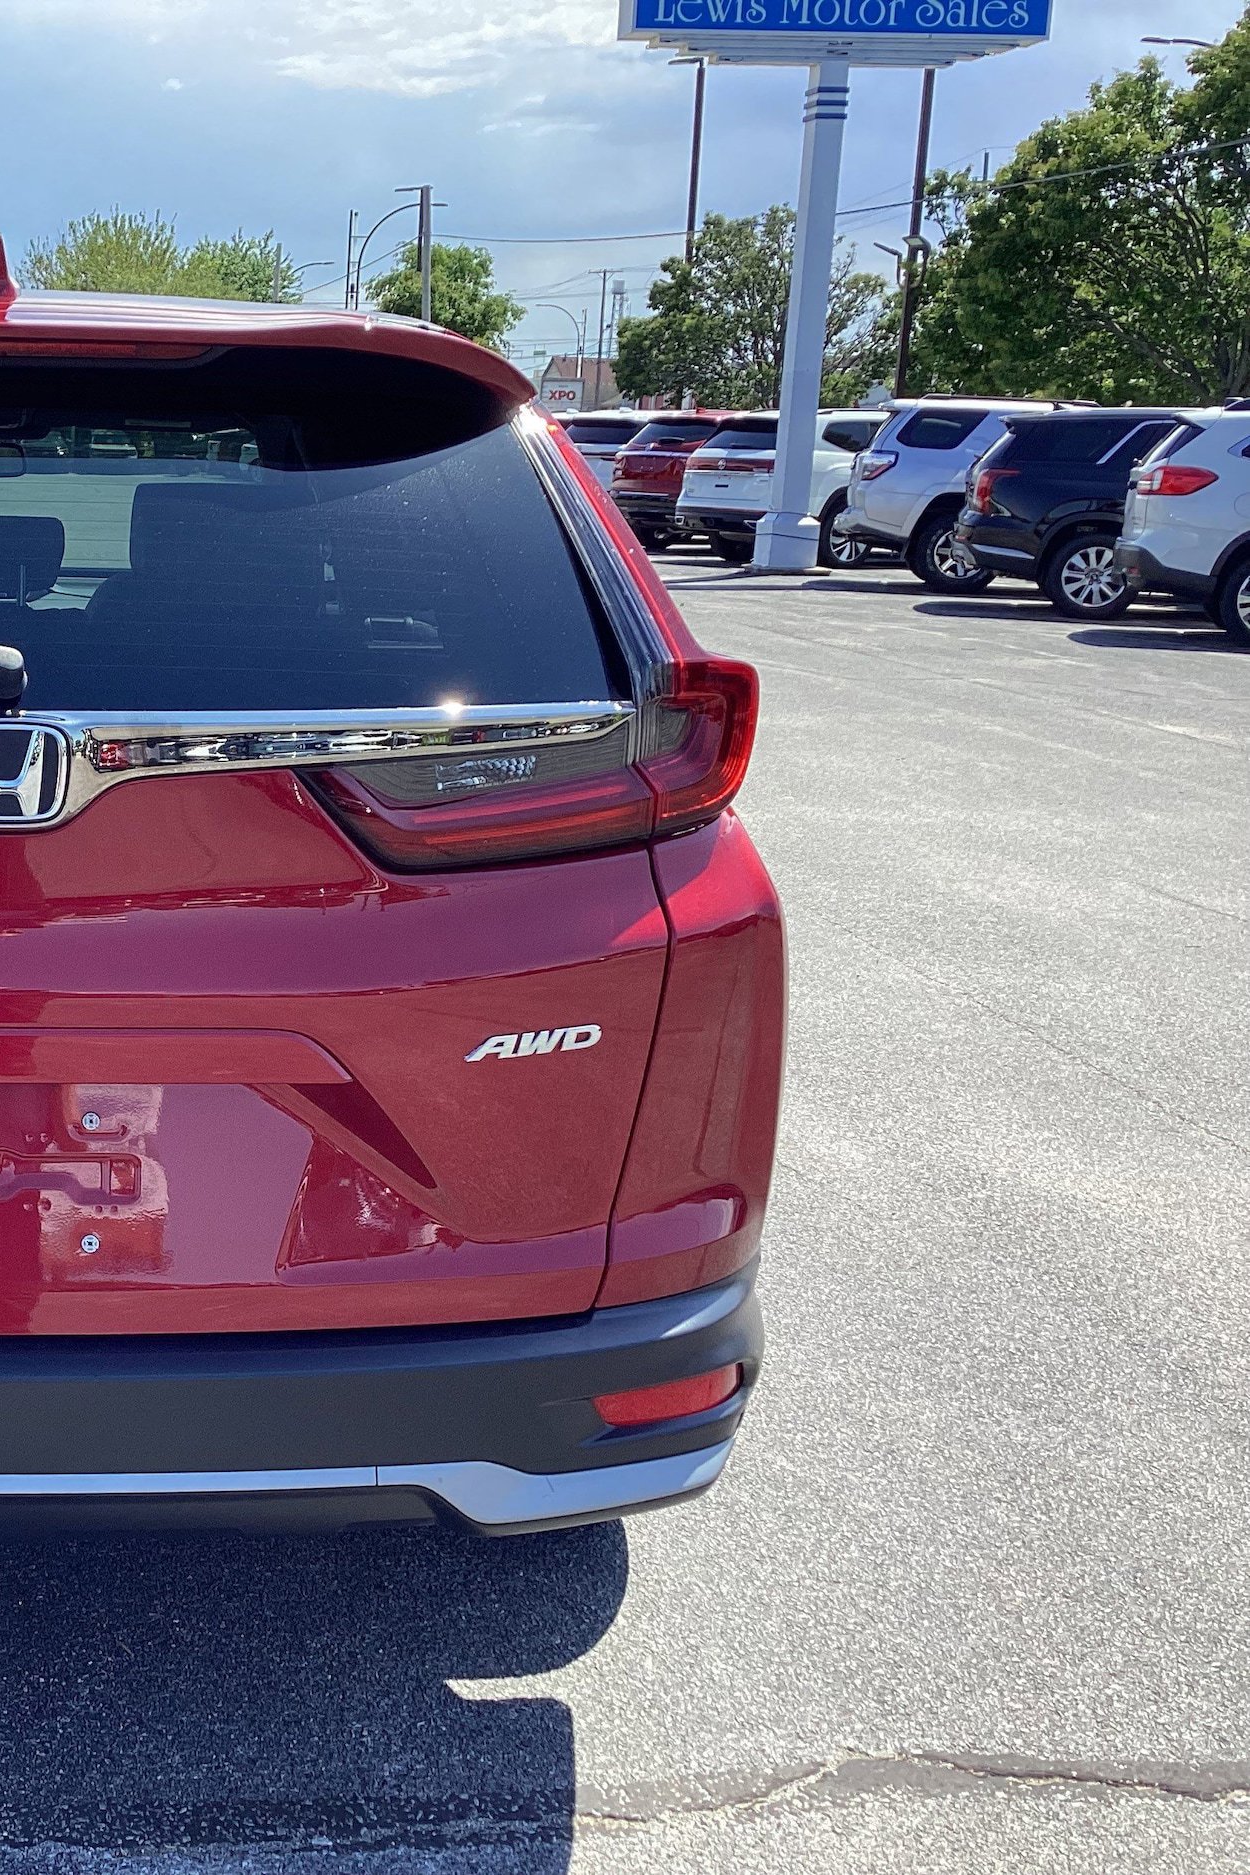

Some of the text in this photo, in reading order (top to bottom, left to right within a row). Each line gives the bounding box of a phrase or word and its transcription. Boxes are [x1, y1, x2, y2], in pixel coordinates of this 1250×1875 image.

[654, 0, 1030, 28] Lewis Motor Sales
[549, 390, 576, 401] XPO
[463, 1024, 602, 1063] AWD
